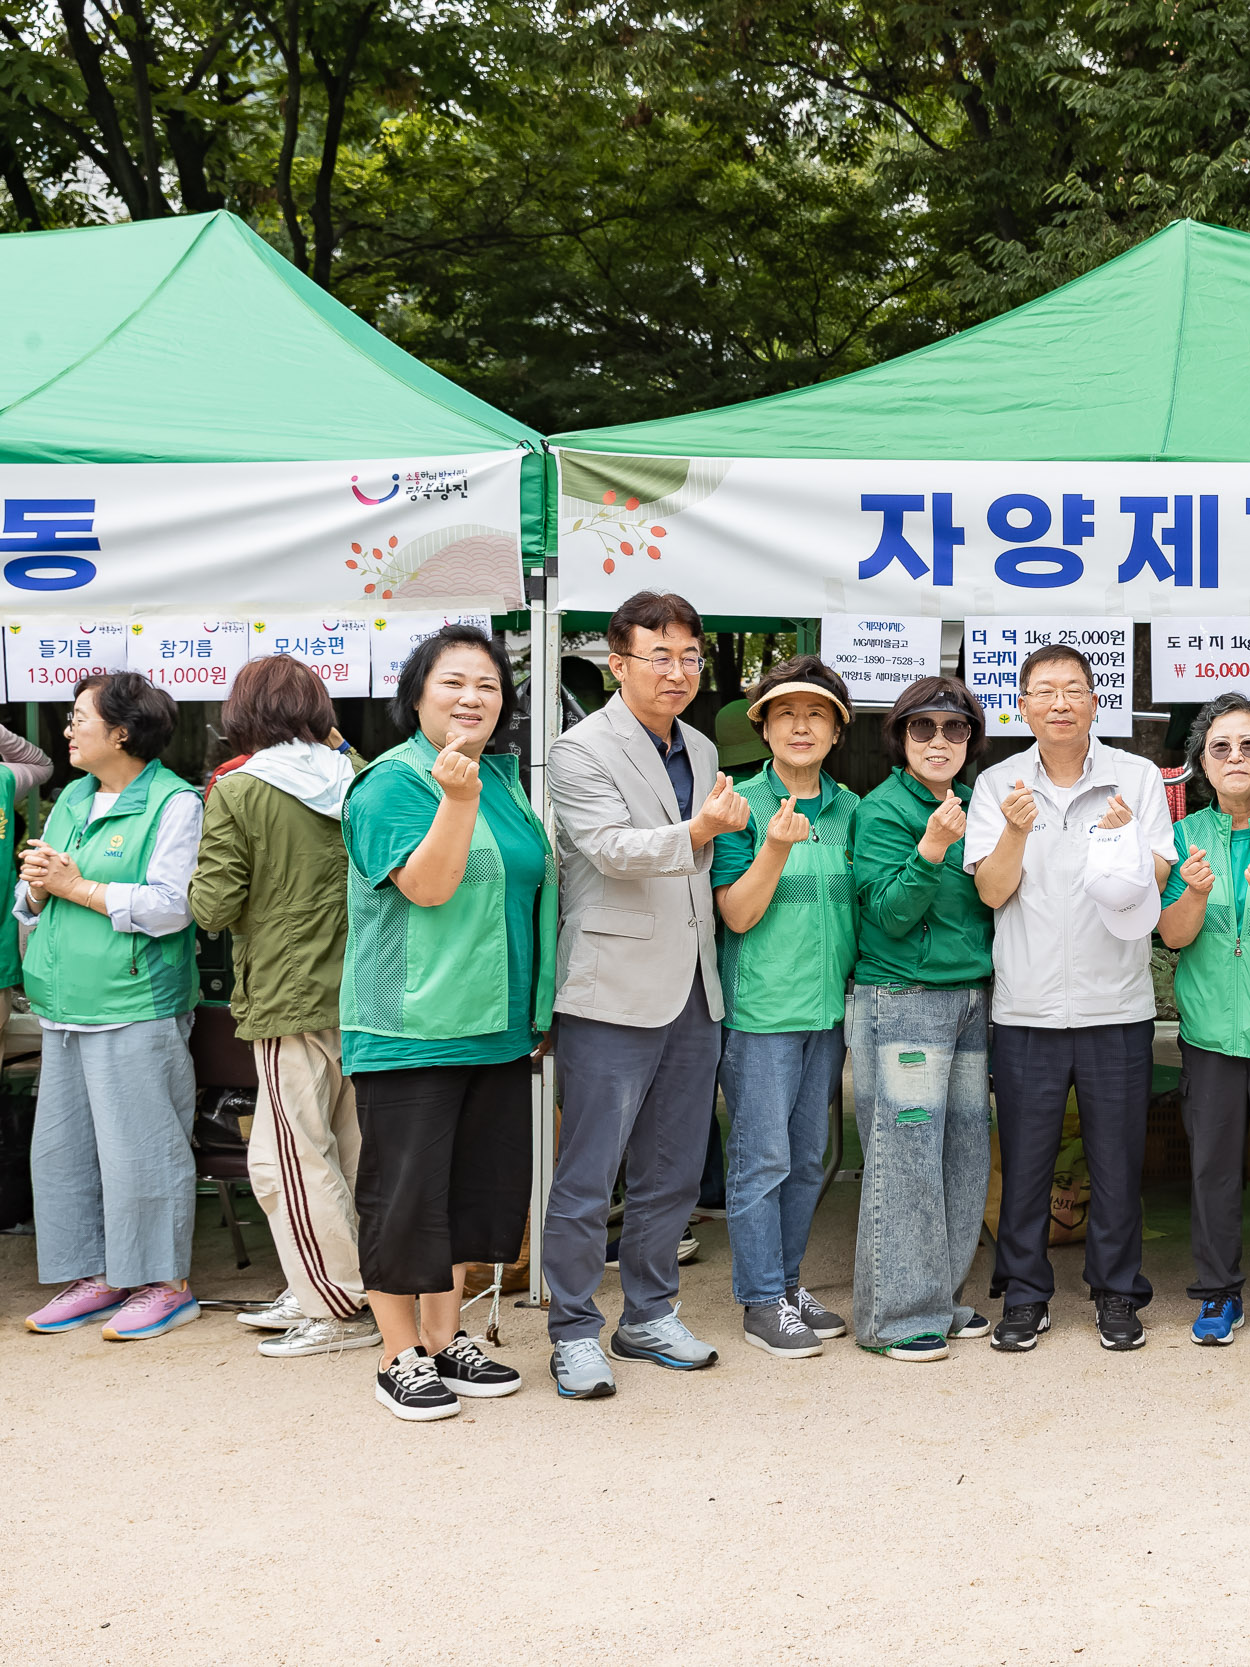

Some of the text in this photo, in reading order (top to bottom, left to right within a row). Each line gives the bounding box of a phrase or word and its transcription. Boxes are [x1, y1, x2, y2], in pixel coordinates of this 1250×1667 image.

[0, 499, 101, 591] 동
[273, 636, 345, 656] 모시송편
[853, 638, 909, 649] MG새마을금고
[1024, 630, 1052, 647] 1kg
[1058, 630, 1126, 647] 25,000원
[38, 639, 93, 659] 들기름
[159, 639, 213, 659] 참기름
[836, 654, 926, 667] 9002-1890-7528-3
[972, 650, 1125, 668] 도라지 000원
[147, 666, 227, 686] 11,000원
[972, 672, 1125, 688] 모시떡 00원
[1195, 662, 1250, 680] 16,000
